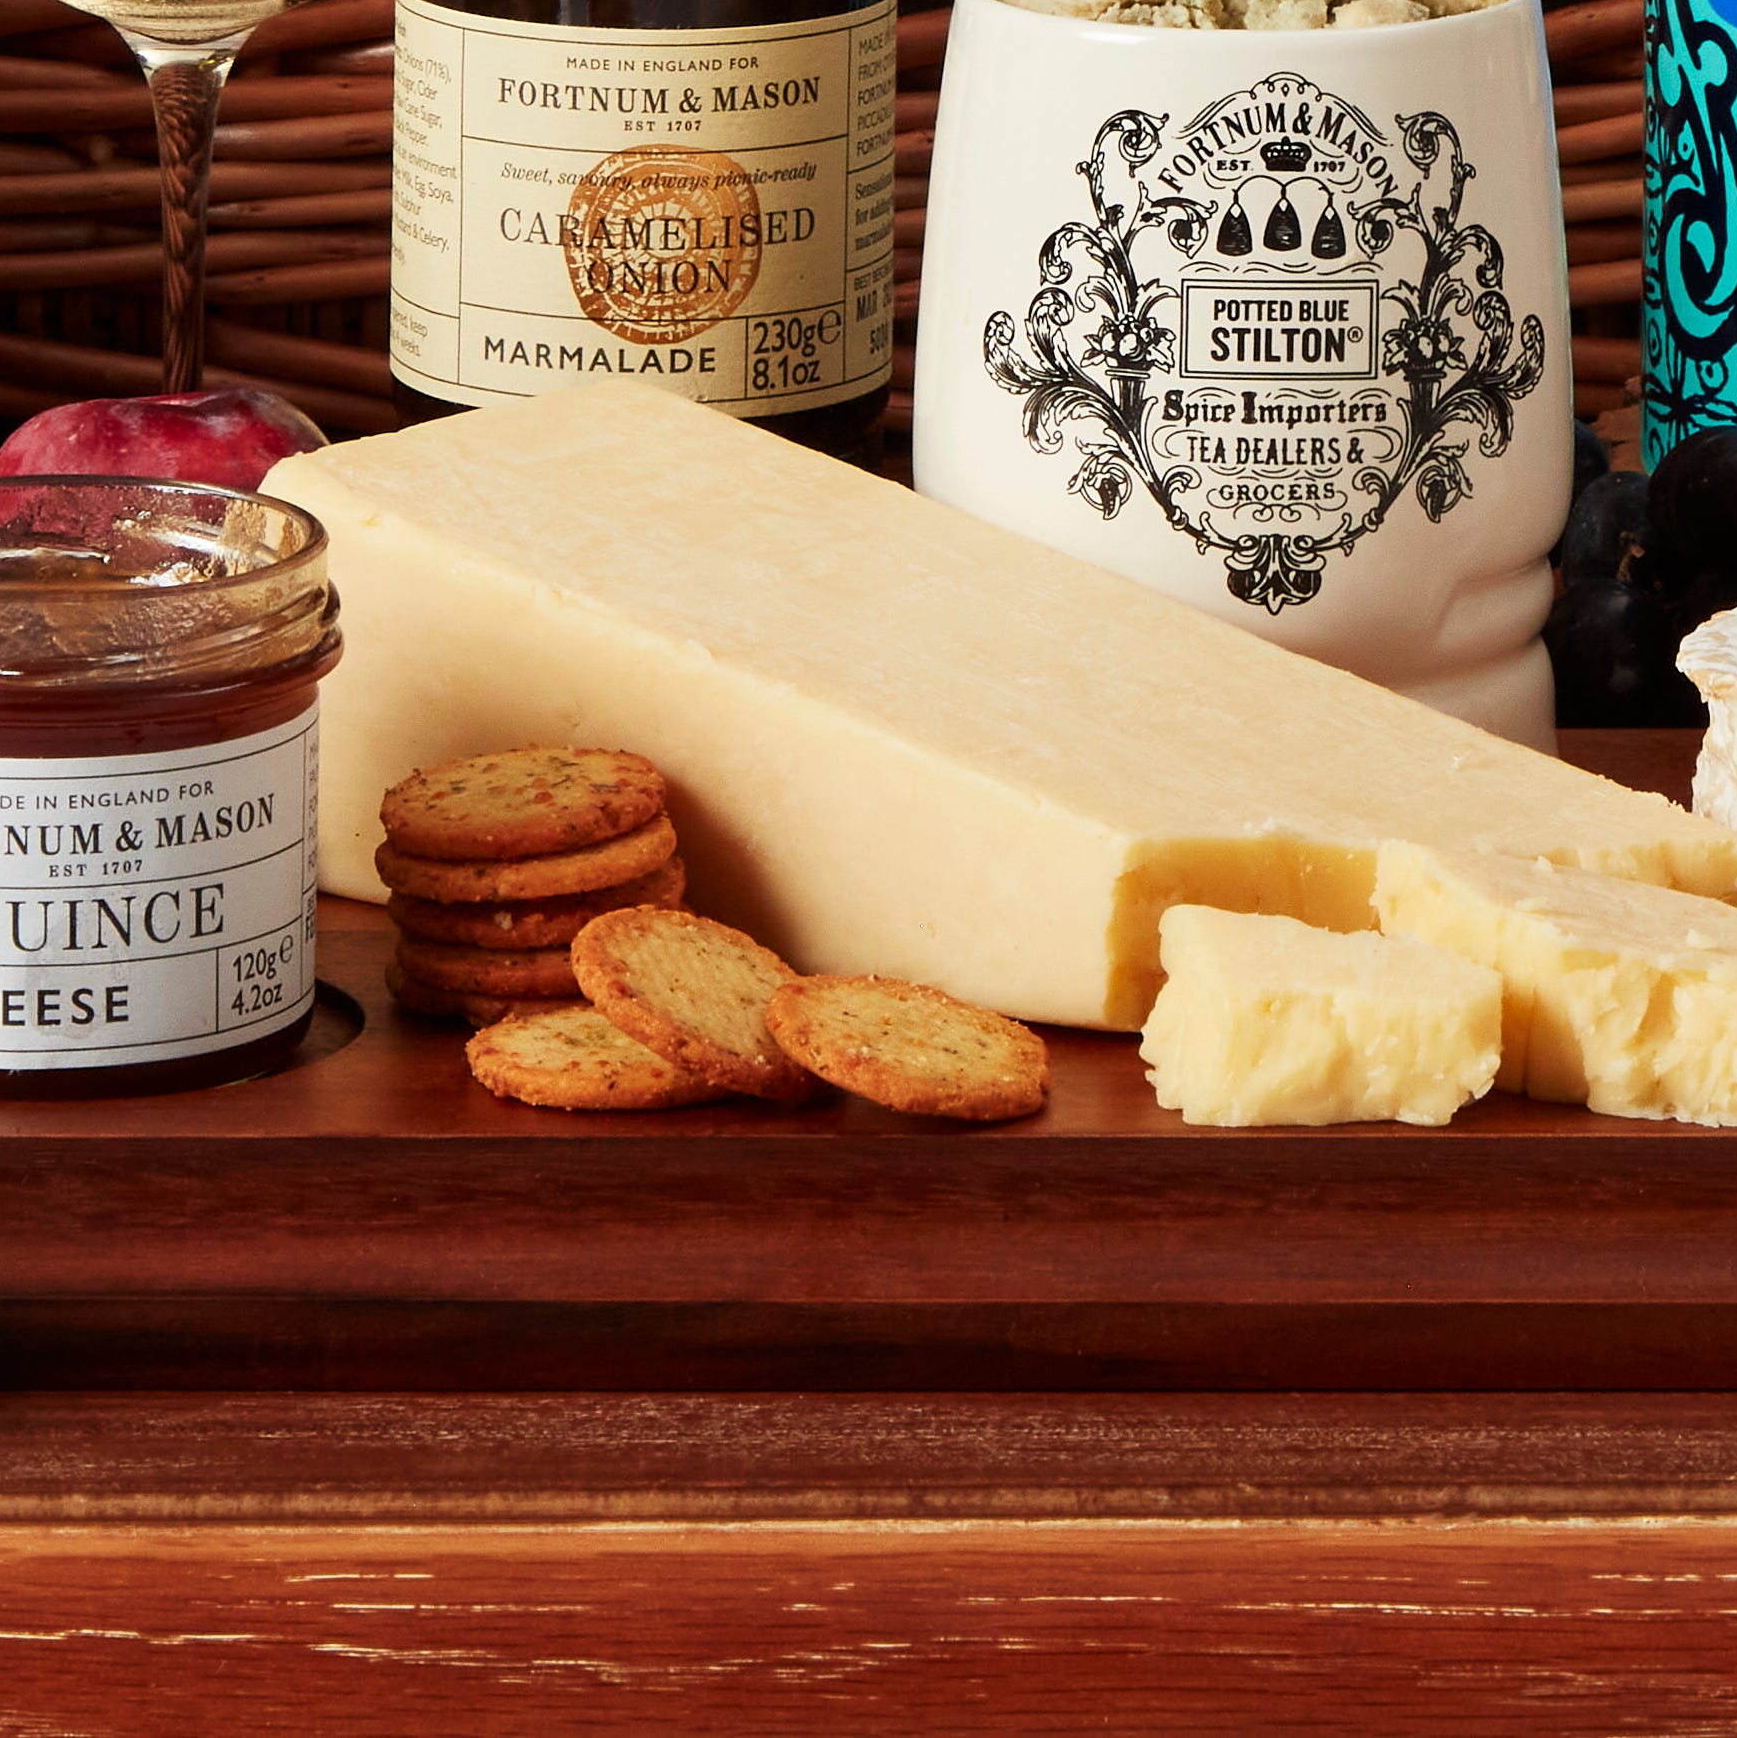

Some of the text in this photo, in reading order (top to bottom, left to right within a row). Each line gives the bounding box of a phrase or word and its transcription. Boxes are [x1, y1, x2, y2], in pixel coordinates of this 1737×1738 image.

[567, 56, 759, 73] MADE IN ENGLAND FOR
[498, 77, 667, 114] FORTNUM
[679, 91, 702, 113] &
[711, 77, 820, 113] MASON
[1158, 102, 1398, 198] FORTNUM & MASON
[1314, 161, 1346, 172] 1707
[501, 162, 817, 191] Sweet, savoury, always picnic-ready
[500, 208, 815, 251] CARAMELISED
[587, 261, 730, 295] ONION
[1213, 299, 1348, 322] POTTED BLUE
[484, 336, 716, 374] MARMALADE
[753, 356, 820, 391] 8.1oz
[1162, 389, 1387, 429] Spice Importers
[1186, 437, 1364, 465] TEA DEALERS &
[1219, 483, 1335, 502] GROCERS
[36, 796, 57, 809] IN
[69, 788, 170, 809] ENGLAND
[179, 781, 213, 799] FOR
[115, 820, 143, 852] &
[155, 793, 276, 849] MASON
[232, 982, 282, 1016] 4.2oz
